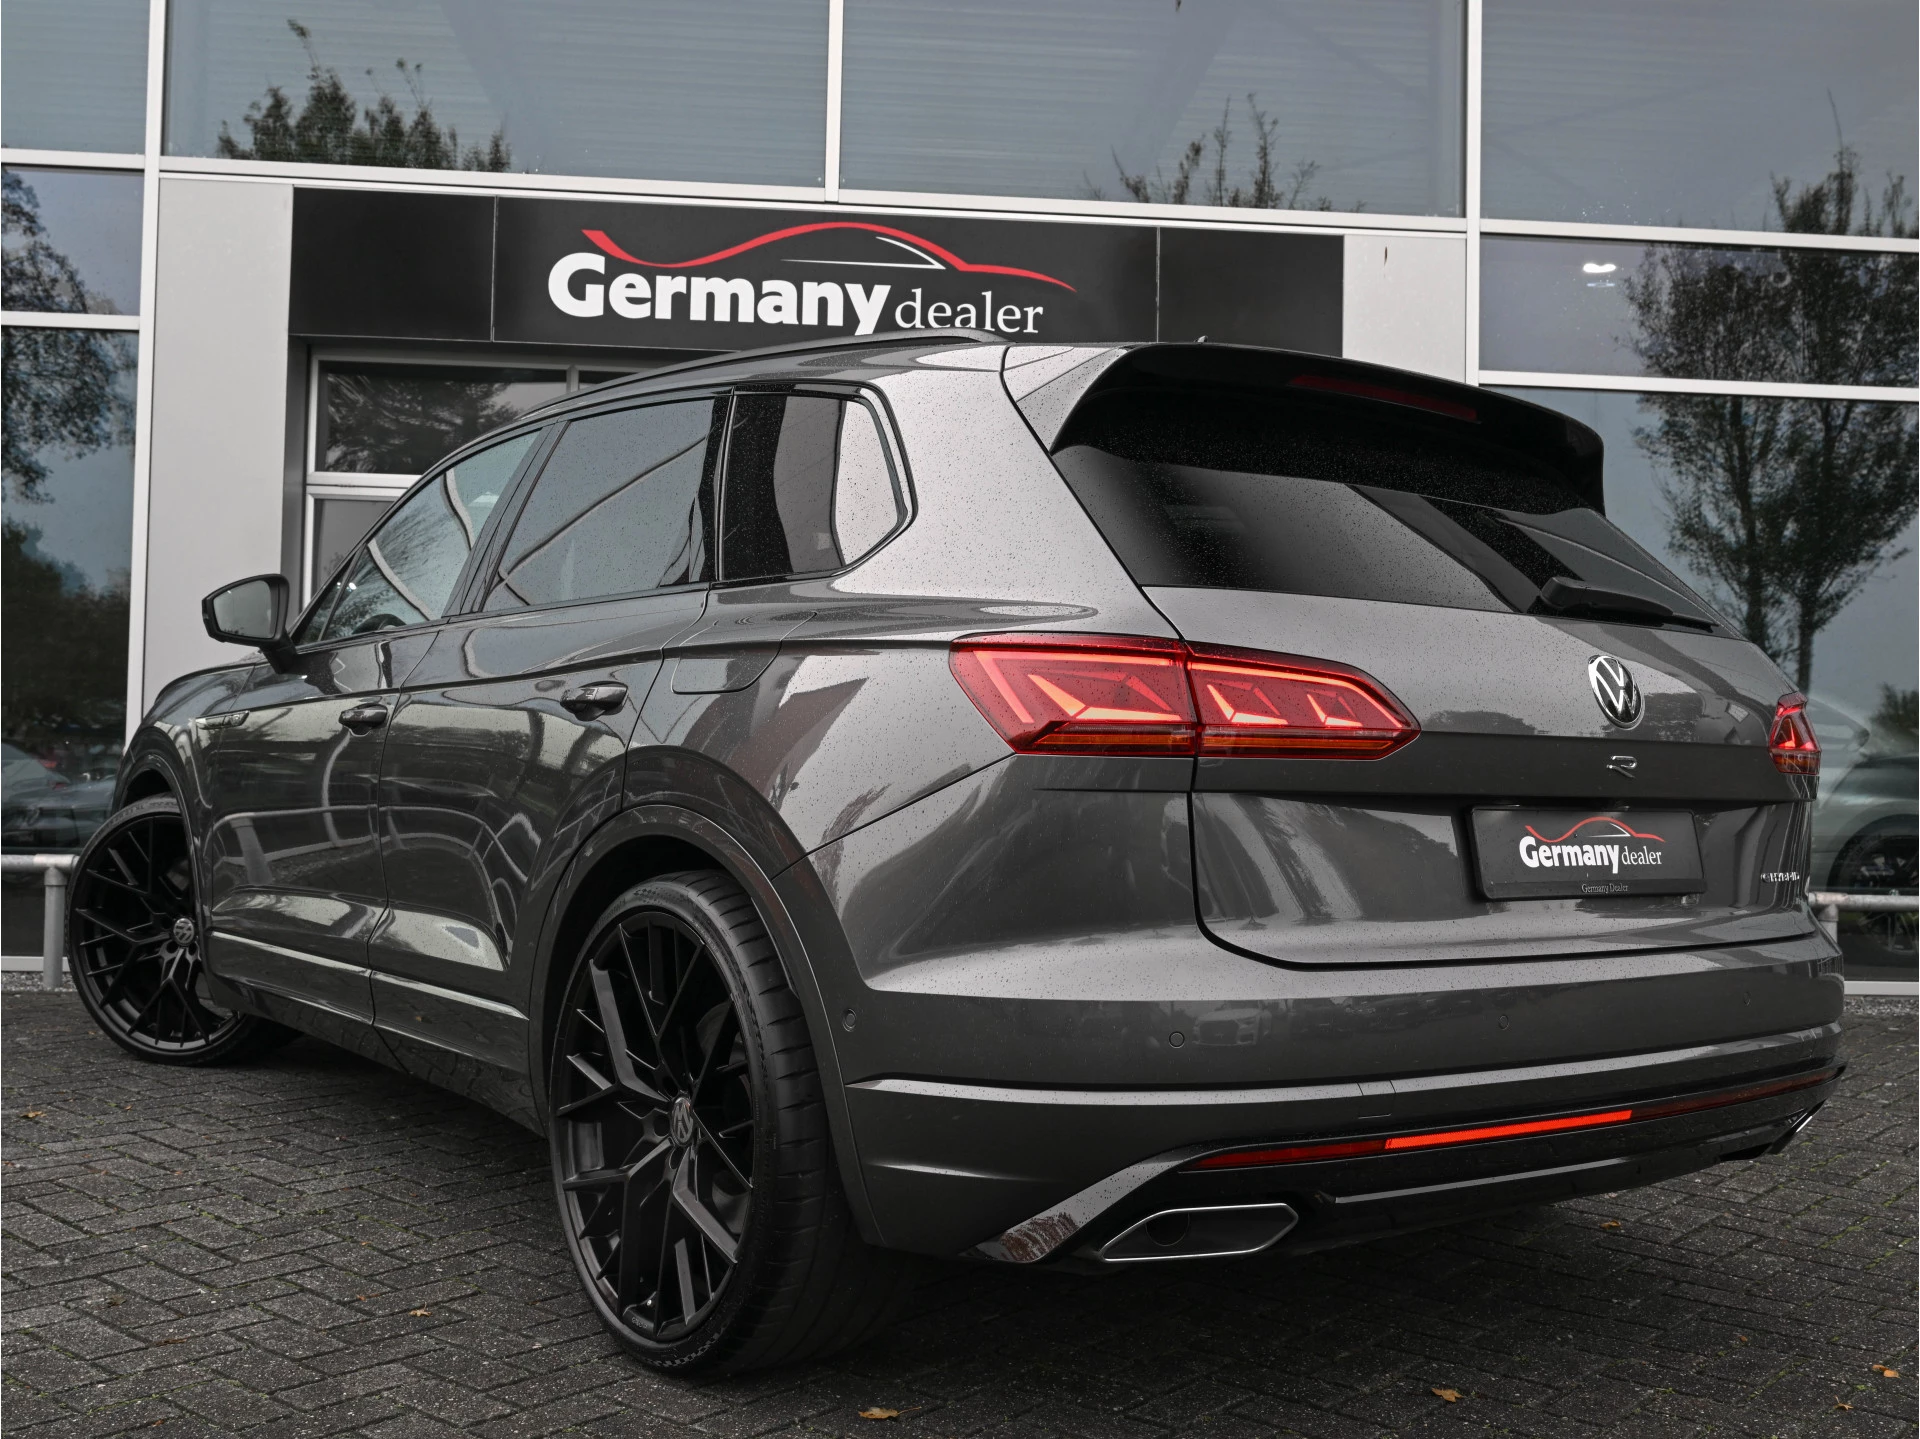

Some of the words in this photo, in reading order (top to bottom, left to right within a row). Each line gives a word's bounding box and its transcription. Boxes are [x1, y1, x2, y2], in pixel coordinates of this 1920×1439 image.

[548, 252, 891, 335] Germany
[895, 288, 1044, 334] dealer
[1519, 835, 1620, 874] Germany
[1621, 845, 1663, 866] dealer
[1581, 883, 1609, 894] Germany
[1609, 882, 1629, 893] Dealer
